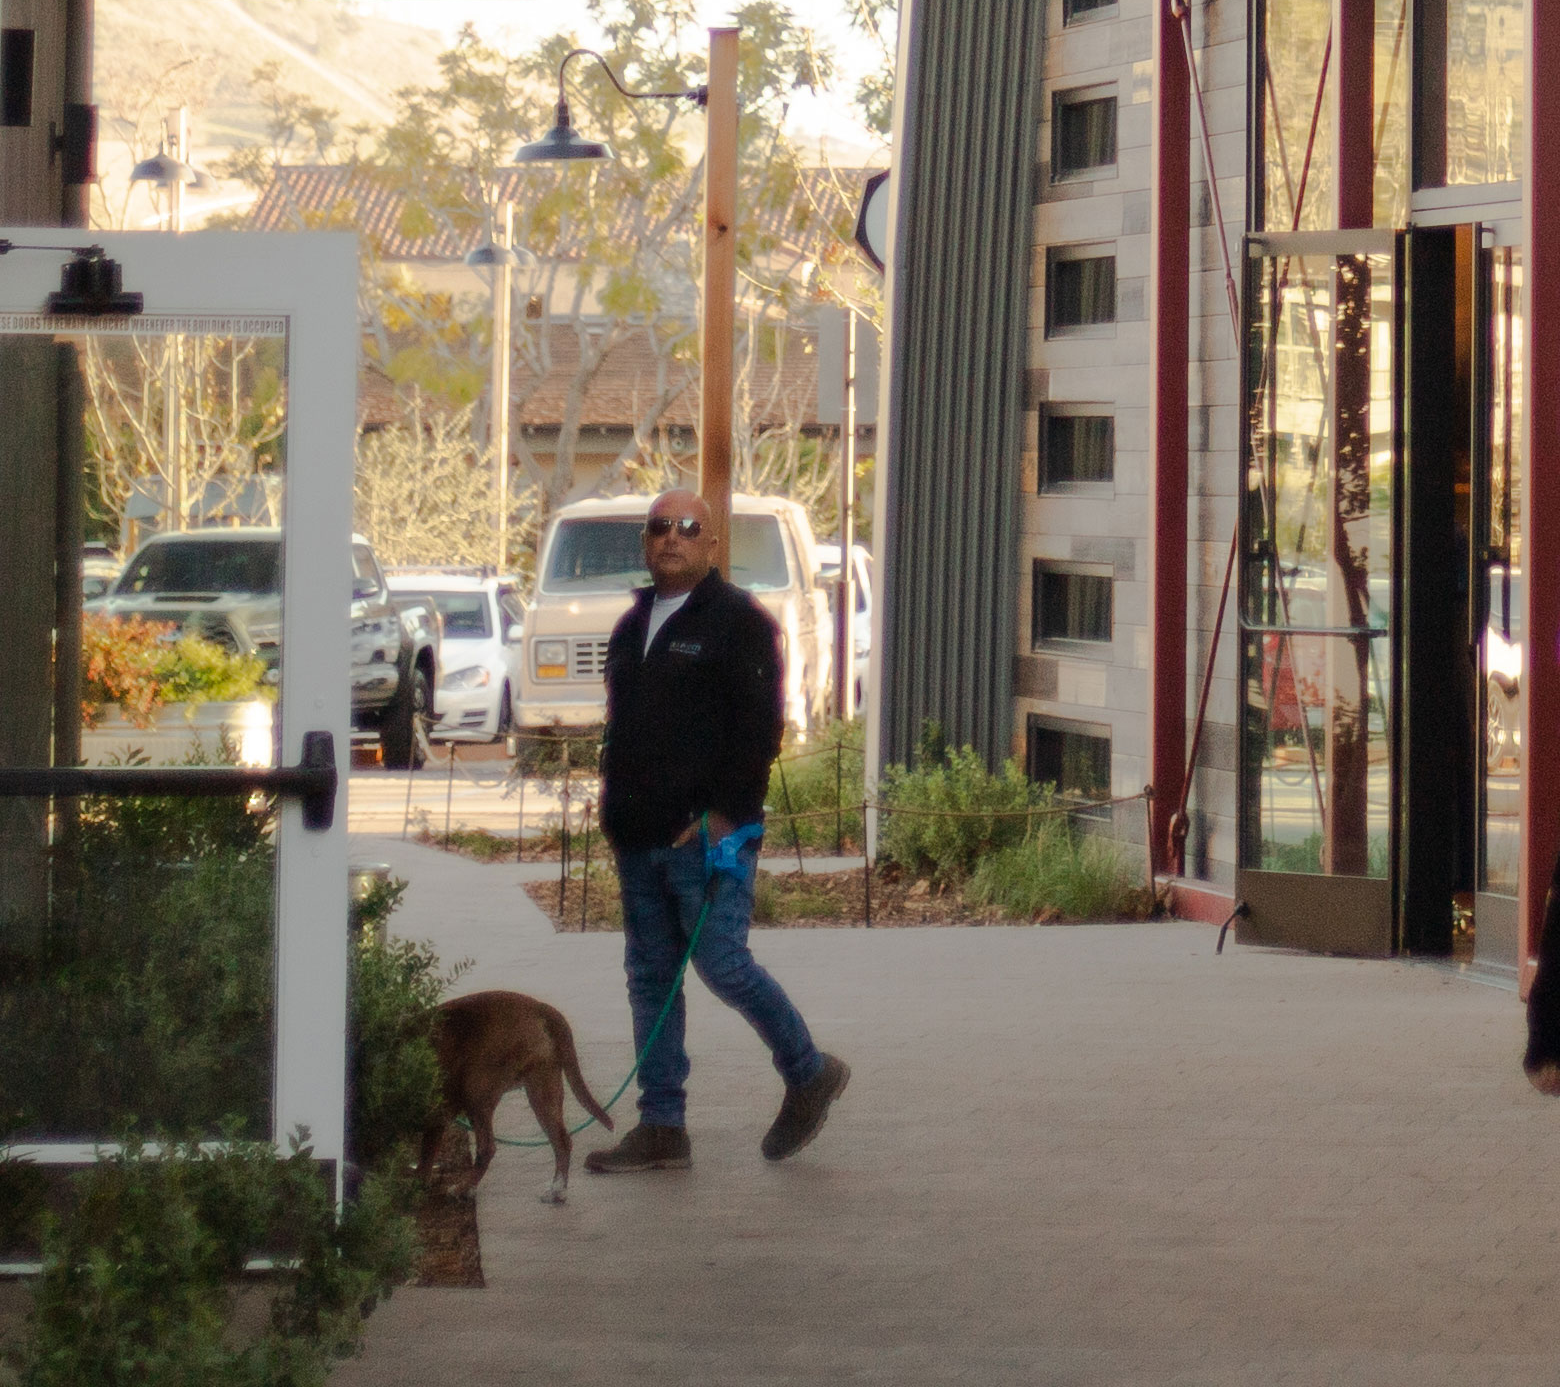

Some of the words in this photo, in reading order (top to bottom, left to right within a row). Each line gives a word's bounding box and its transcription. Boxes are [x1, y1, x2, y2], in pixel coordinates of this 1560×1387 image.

[13, 316, 40, 330] DOORS
[131, 318, 175, 332] WHENEVER
[193, 319, 232, 333] BUILDING
[243, 320, 284, 334] OCCUPIED
